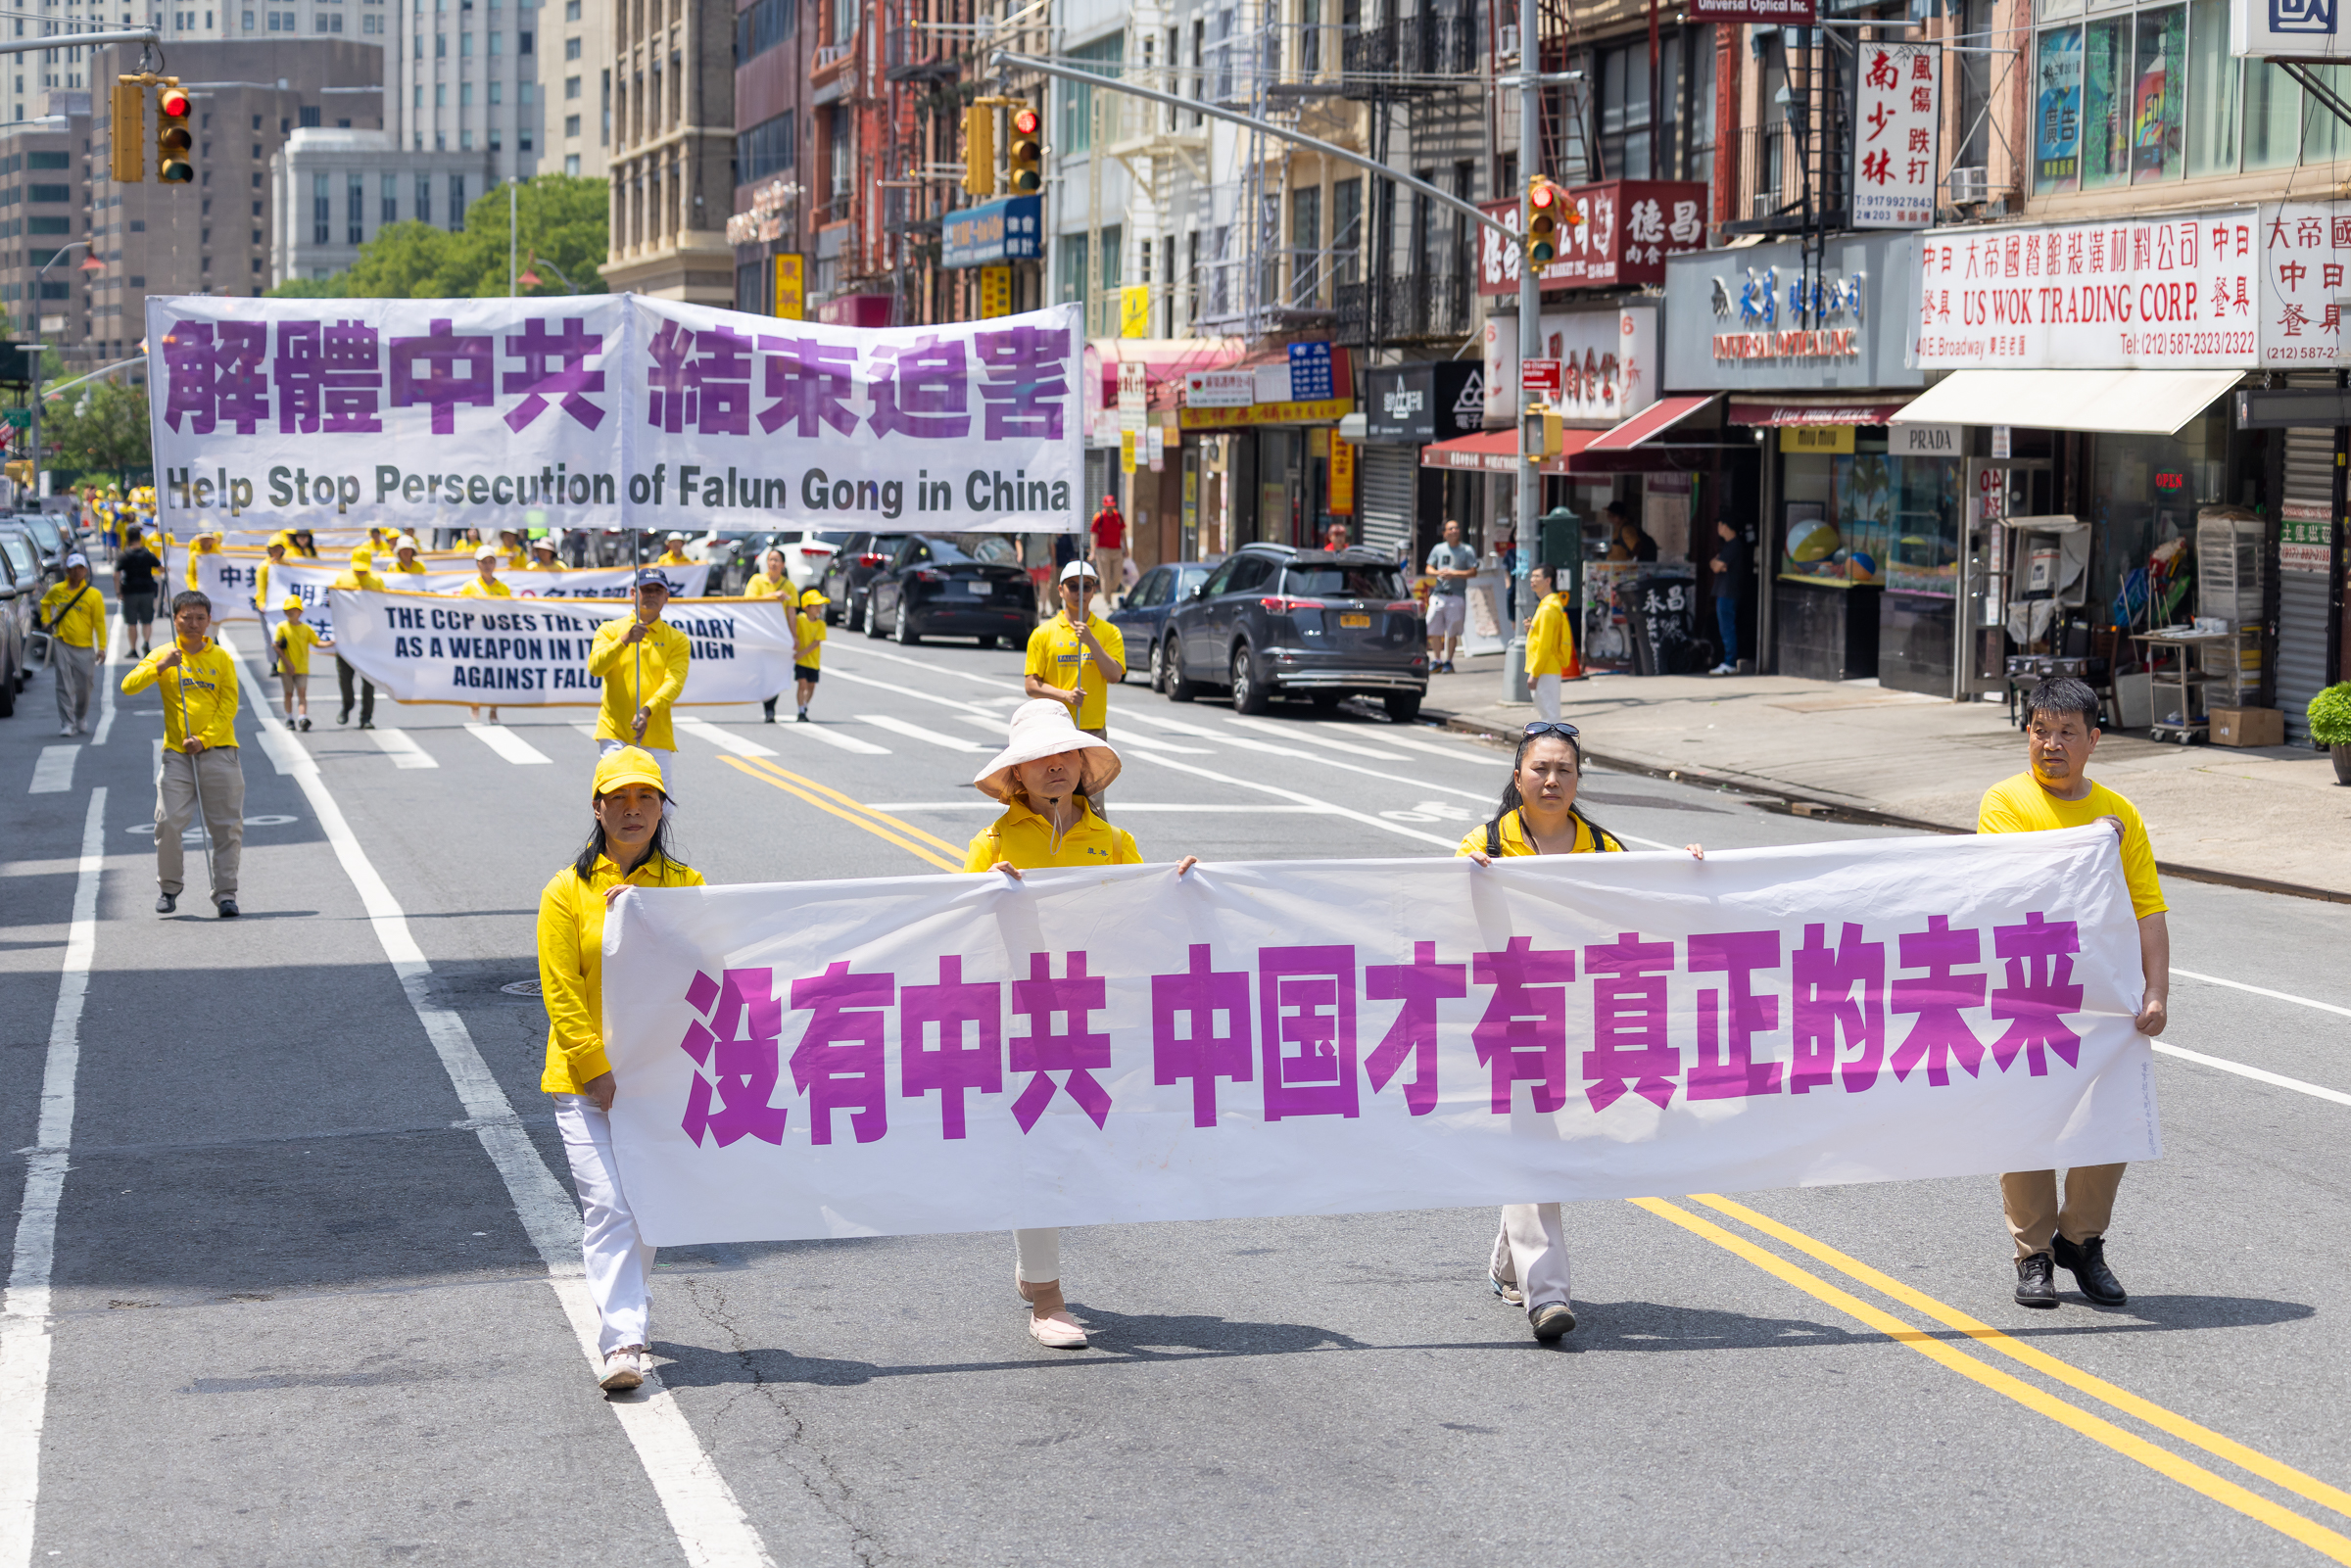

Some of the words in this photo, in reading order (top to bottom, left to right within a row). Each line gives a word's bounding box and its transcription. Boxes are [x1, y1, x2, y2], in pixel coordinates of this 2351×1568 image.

[1861, 50, 1899, 186] 南少林
[1907, 54, 1933, 184] 風傷跌打
[2043, 105, 2076, 144] 廣告
[1626, 198, 1703, 244] 德昌
[1965, 221, 2199, 279] 大帝國餐館裝潢材料公司
[2212, 220, 2250, 261] 中日
[1923, 242, 1952, 277] 中日
[2279, 260, 2345, 293] 中日
[1963, 290, 1987, 326] US
[1991, 288, 2033, 324] WOK
[2039, 284, 2133, 323] TRADING
[2139, 281, 2198, 322] CORP.
[1622, 315, 1634, 335] 6
[1712, 331, 1775, 359] UNIVERSAL
[1775, 328, 1829, 356] OPTICAL
[1939, 336, 1986, 360] Broadway
[2120, 332, 2139, 355] Tel:
[2141, 332, 2167, 357] (212)
[2170, 330, 2254, 355] 587-2323/2322
[2267, 347, 2298, 359] (212)
[2300, 347, 2339, 359] 587-2
[163, 317, 605, 435] 解體中共
[648, 318, 1072, 441] 結束迫害
[1455, 413, 1484, 429] 電子
[1909, 429, 1952, 450] PRADA
[166, 466, 253, 517] Help
[268, 465, 360, 514] Stop
[375, 462, 615, 505] Persecution
[629, 463, 666, 505] of
[679, 465, 787, 508] Falun
[801, 467, 903, 519] Gong
[918, 469, 951, 511] in
[965, 469, 1070, 512] China
[2156, 473, 2183, 488] OPEN
[1642, 585, 1685, 615] 永昌
[384, 607, 425, 629] THE
[431, 608, 475, 630] CCP
[481, 613, 538, 632] USES
[541, 613, 583, 632] THE
[395, 636, 423, 658] AS
[430, 637, 444, 658] A
[448, 637, 543, 660] WEAPON
[549, 639, 571, 660] IN
[453, 665, 548, 689] AGAINST
[553, 668, 602, 689] FALU
[682, 951, 1114, 1149] 没有中共
[1151, 912, 2084, 1127] 中国才有真正的未来
